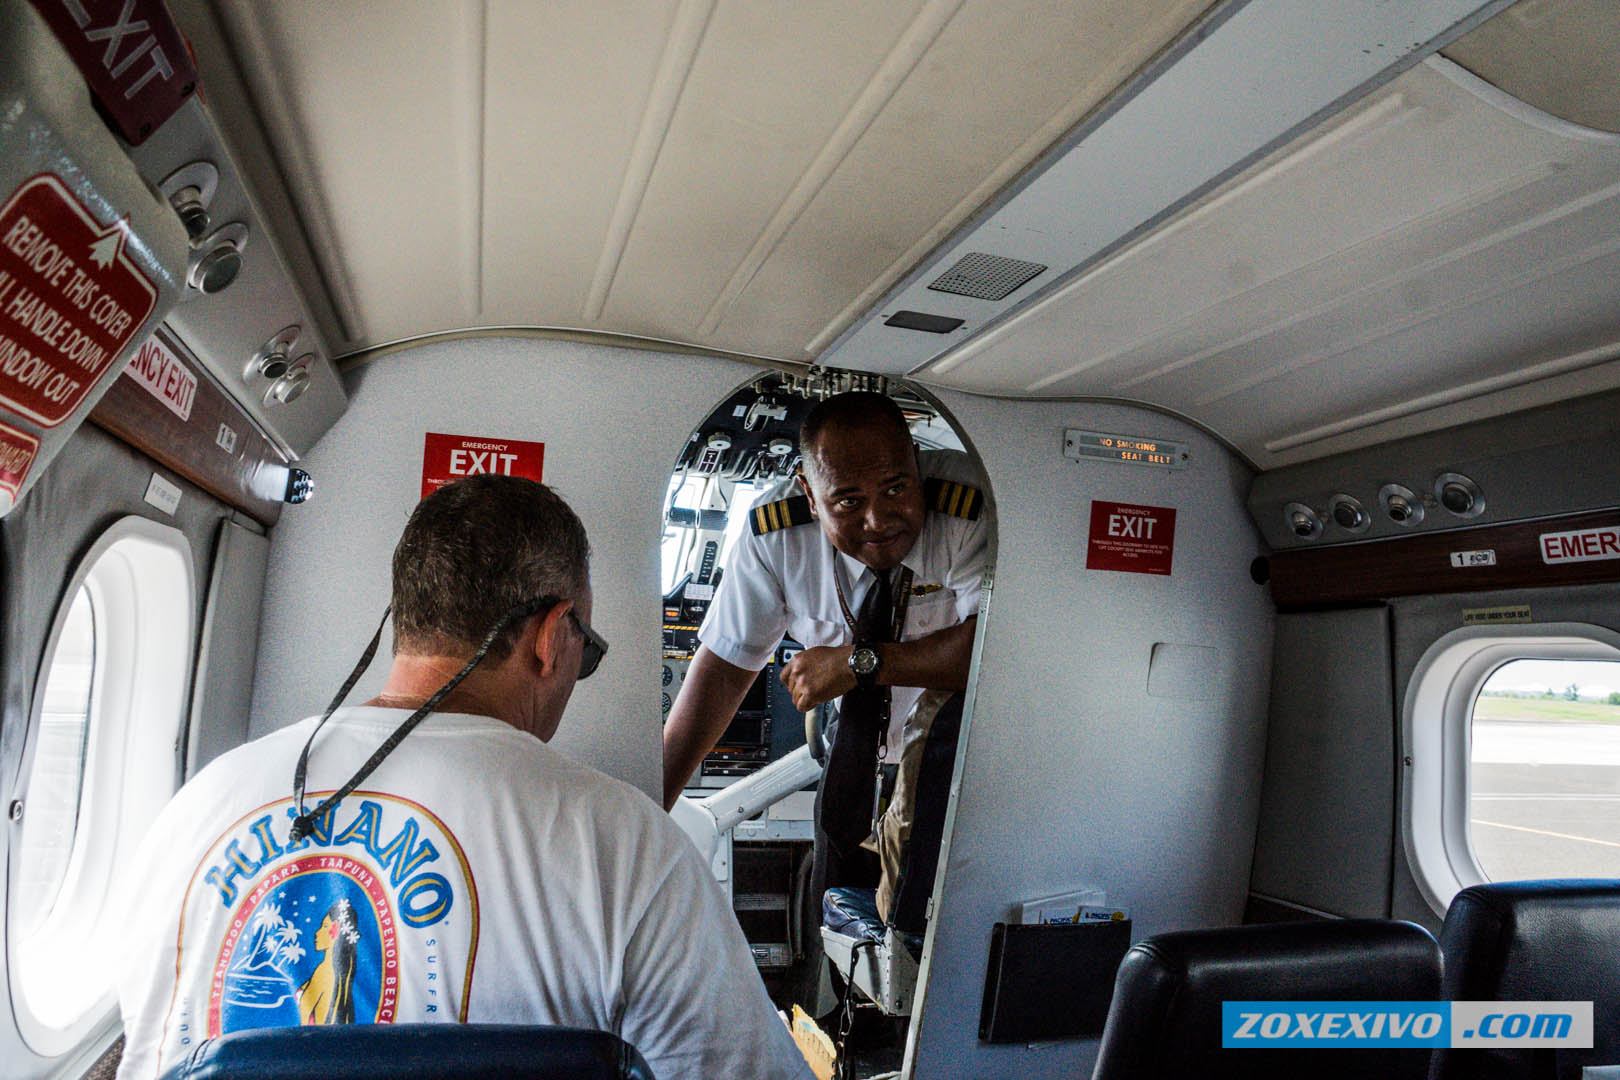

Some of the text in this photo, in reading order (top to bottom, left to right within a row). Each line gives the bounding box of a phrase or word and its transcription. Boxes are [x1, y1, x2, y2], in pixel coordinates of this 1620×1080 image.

[2, 215, 133, 340] REMOVE THIS COVER
[4, 287, 72, 346] HANDLE
[58, 327, 108, 374] DOWN
[43, 373, 80, 406] OUT
[130, 342, 195, 413] NCY EXIT
[462, 441, 508, 452] EMERGENCY
[1099, 438, 1157, 452] NO SMOKING
[1121, 452, 1171, 464] SEAT BELT
[449, 449, 518, 476] EXIT
[1108, 514, 1157, 539] EXIT
[1456, 553, 1464, 566] 1
[204, 800, 454, 929] HINANO
[211, 919, 243, 999] TEAHUPOO
[250, 863, 300, 905] PAPARA
[319, 857, 374, 888] TAAPUNA
[376, 898, 396, 970] PAPENOO
[425, 938, 438, 1022] SURFR
